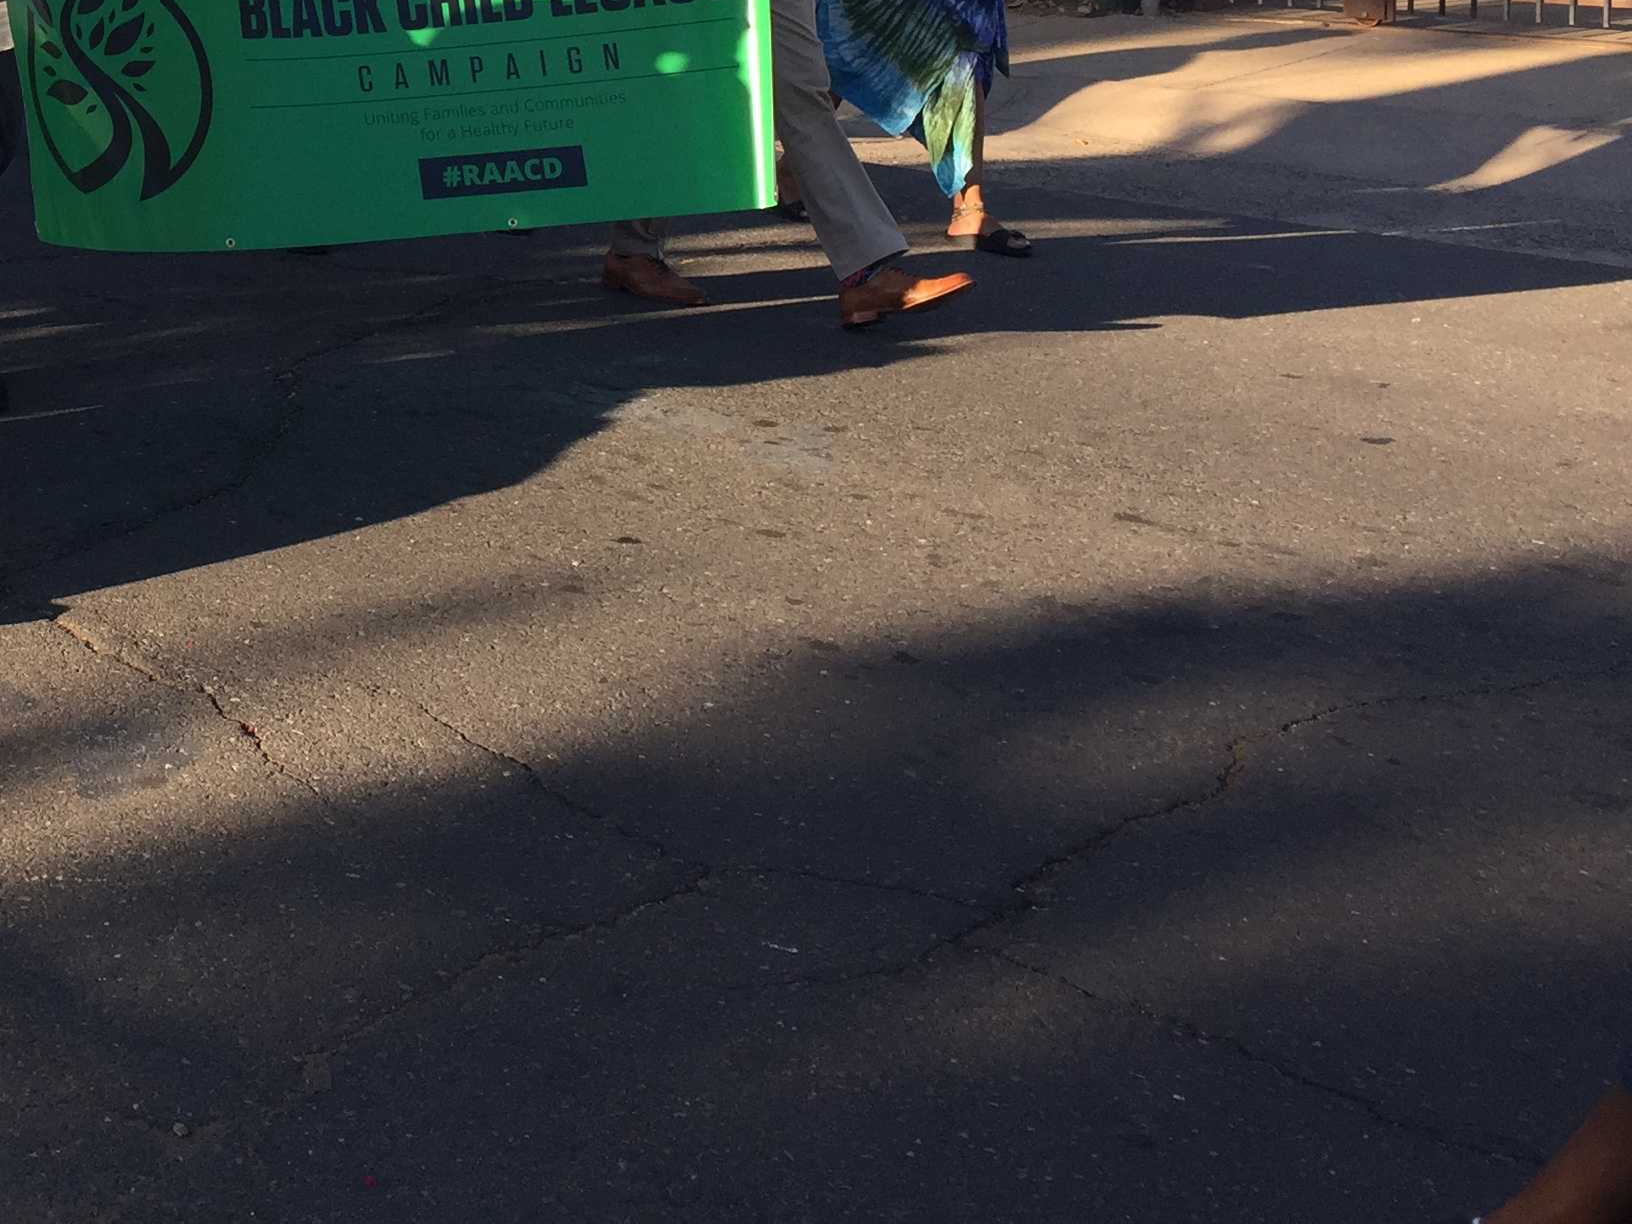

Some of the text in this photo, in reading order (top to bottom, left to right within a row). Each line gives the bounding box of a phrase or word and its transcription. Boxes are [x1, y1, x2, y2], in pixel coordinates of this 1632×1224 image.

[358, 43, 620, 92] CAMPAIGN
[364, 90, 627, 127] Uniting Families and Communities
[420, 117, 575, 142] for a Healthy Future
[442, 157, 562, 188] #RAACD
